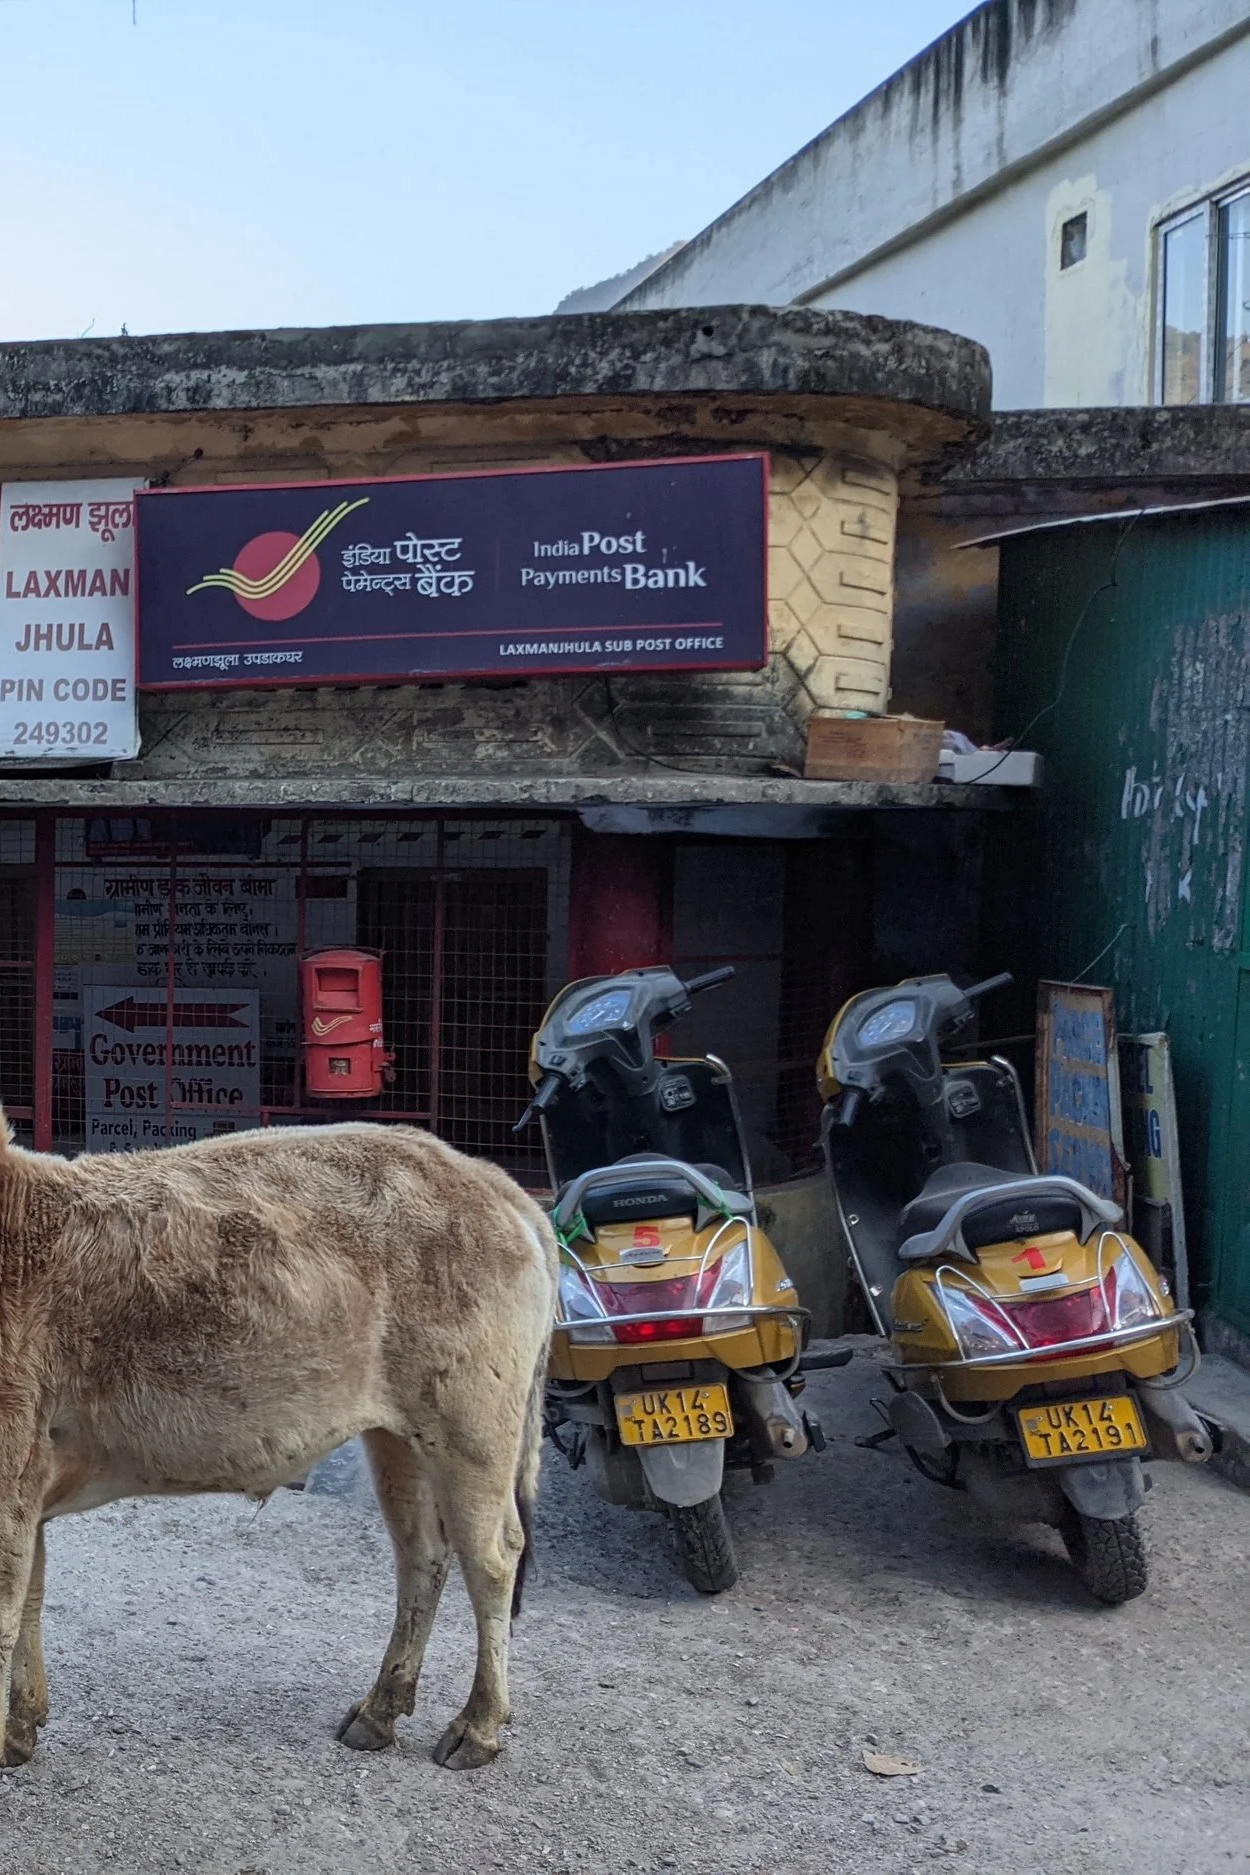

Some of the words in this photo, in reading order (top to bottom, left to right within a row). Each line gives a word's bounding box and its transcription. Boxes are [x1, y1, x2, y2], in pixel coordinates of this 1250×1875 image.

[10, 503, 82, 532] लक्ष्मण
[341, 543, 391, 568] इंडिया
[393, 532, 463, 563] पोस्ट
[6, 569, 130, 599] LAXMAN
[415, 564, 476, 597] बैंक
[520, 566, 622, 590] Payments
[622, 561, 707, 590] Bank
[15, 622, 115, 652] JHULA
[499, 640, 601, 656] LAXMANJHULA
[604, 639, 633, 653] SUB
[636, 638, 672, 652] POST
[674, 637, 724, 650] OFFICE
[172, 653, 241, 671] लक्ष्मणझूला
[243, 650, 304, 666] उपडाकघर
[0, 679, 45, 702] PIN
[53, 678, 127, 702] CODE
[13, 721, 108, 746] 249302
[103, 874, 154, 899] ग्रामीण
[90, 1033, 257, 1068] Government
[103, 1078, 159, 1109] Post
[170, 1077, 244, 1107] Office
[91, 1117, 138, 1139] Parcel,
[612, 1193, 669, 1208] HONDA
[632, 1226, 660, 1248] 5
[1011, 1247, 1046, 1271] 1
[634, 1410, 728, 1441] TA2189
[1038, 1421, 1138, 1456] TA2191
